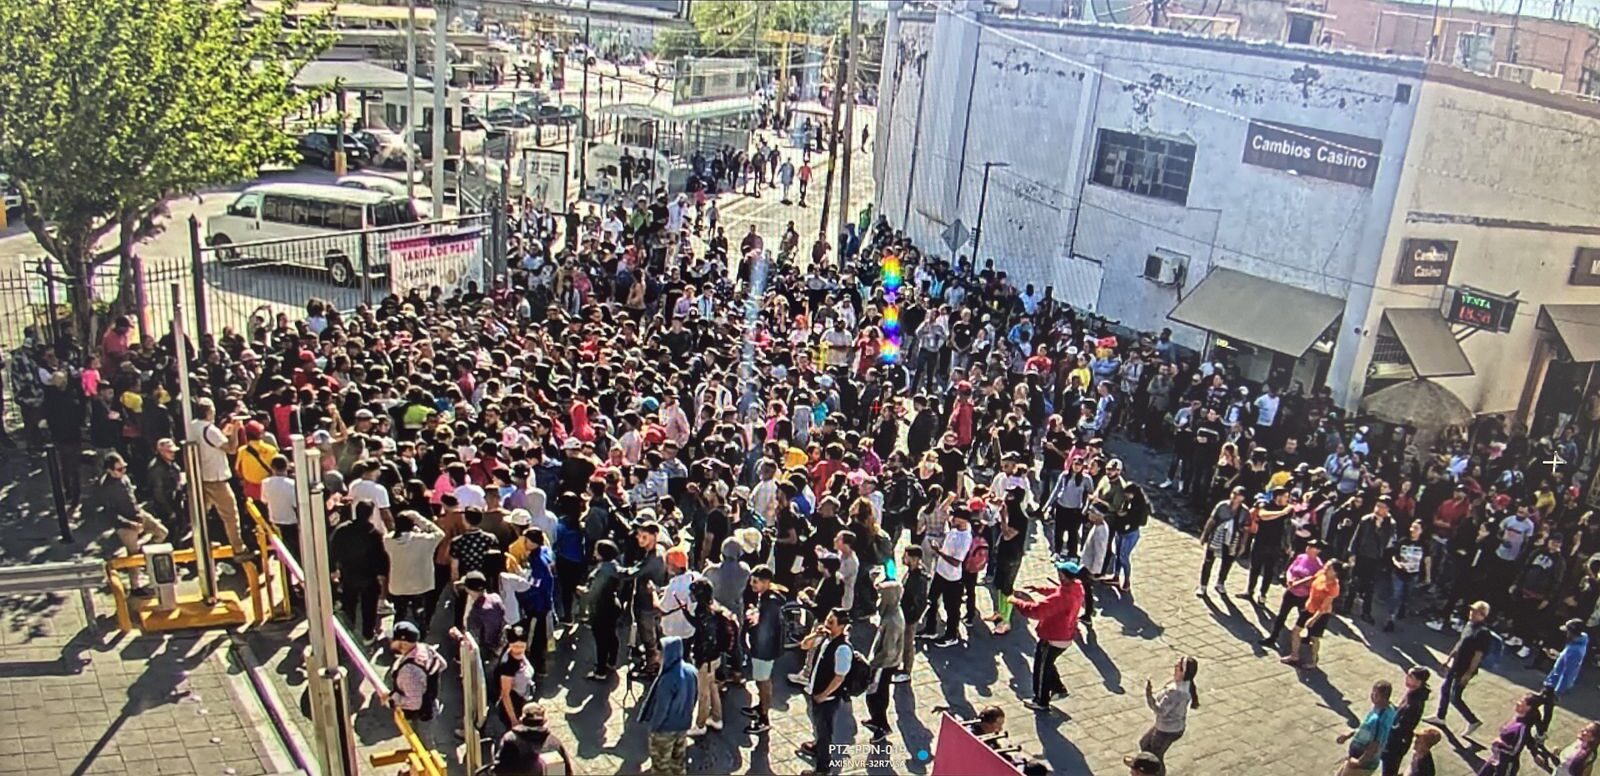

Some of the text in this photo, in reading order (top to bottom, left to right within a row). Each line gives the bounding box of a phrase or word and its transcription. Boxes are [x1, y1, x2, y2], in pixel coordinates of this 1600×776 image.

[1252, 135, 1367, 169] Cambios Casino
[402, 247, 435, 262] TARIFA
[437, 247, 447, 257] DE
[1414, 265, 1442, 277] Casino
